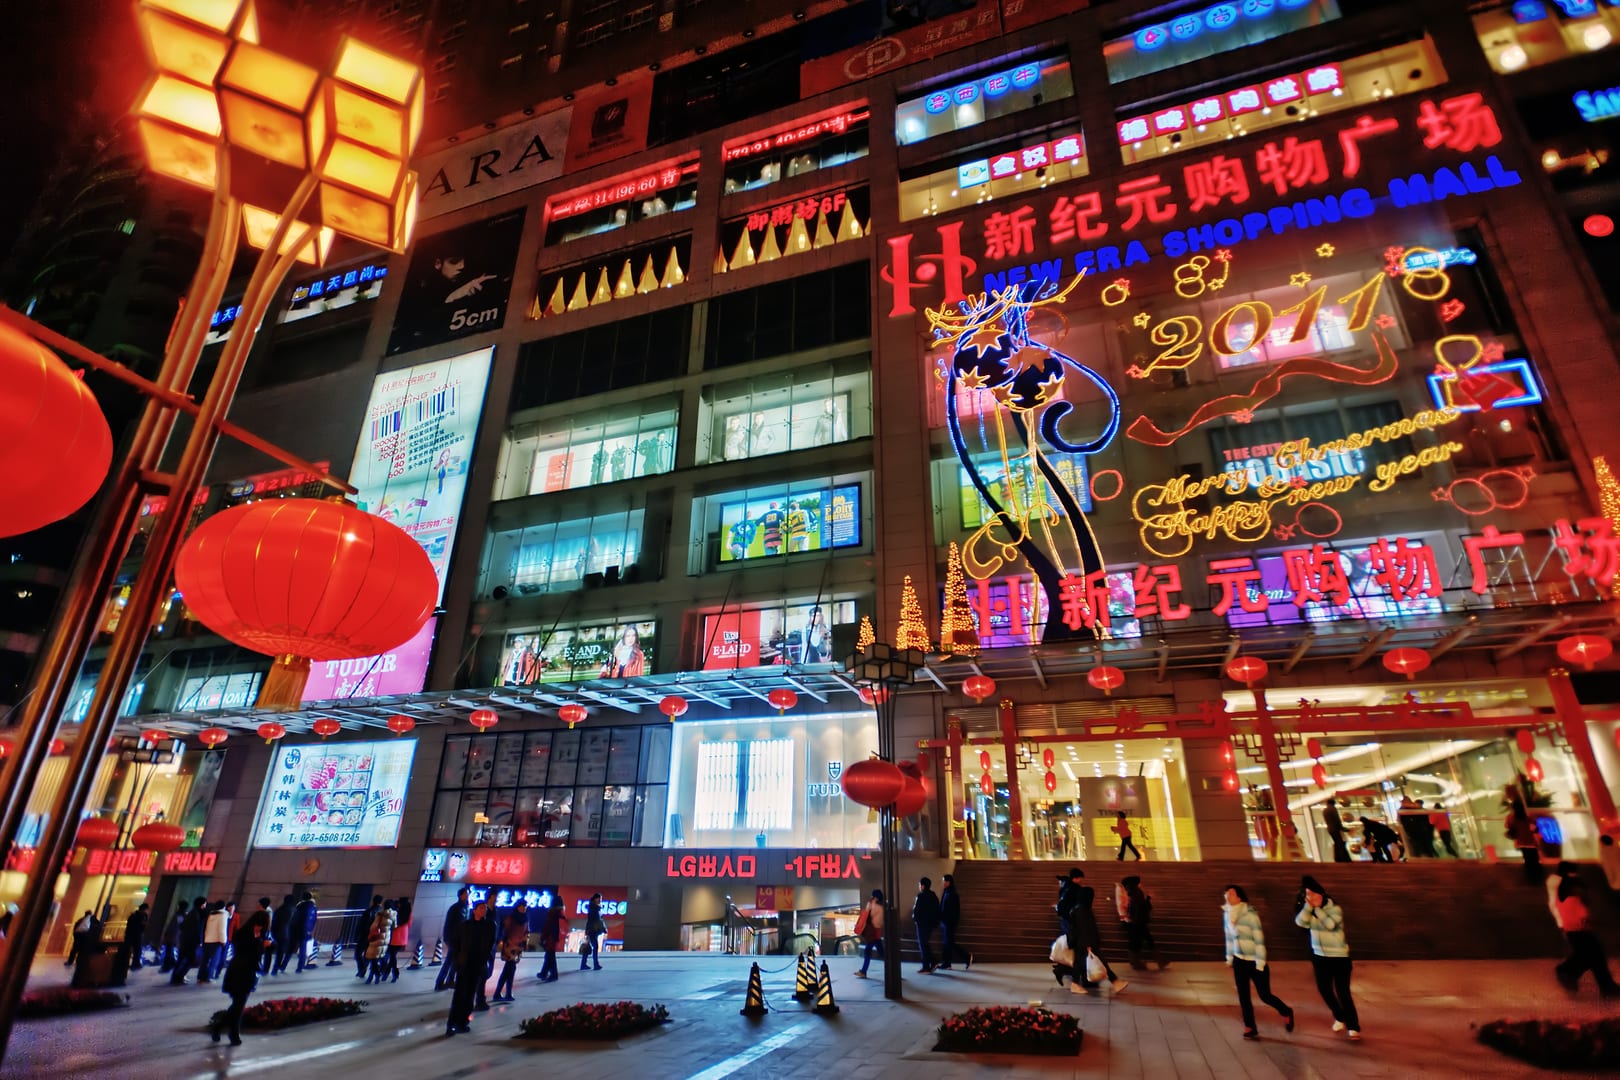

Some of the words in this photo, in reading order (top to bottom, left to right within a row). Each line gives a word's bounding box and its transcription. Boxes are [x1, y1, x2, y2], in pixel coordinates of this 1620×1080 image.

[424, 134, 555, 199] ARA
[983, 92, 1502, 259] 新纪元购物广场
[983, 258, 1063, 293] NEW
[1074, 240, 1152, 276] ERA
[1163, 188, 1375, 258] SHOPPING
[1388, 155, 1522, 208] MALL
[449, 306, 499, 331] 5cm
[1141, 272, 1386, 378] 2011
[1223, 447, 1251, 462] THE
[1287, 475, 1361, 506] new
[1369, 442, 1463, 492] year
[1149, 473, 1249, 505] Merry
[1058, 518, 1620, 631] 新纪元购物广场
[325, 653, 397, 679] TUDOR
[808, 783, 842, 797] TUD
[164, 852, 217, 872] 1F出入口
[667, 855, 756, 878] LG出入口
[784, 853, 872, 879] -1F出入
[760, 887, 773, 896] LG
